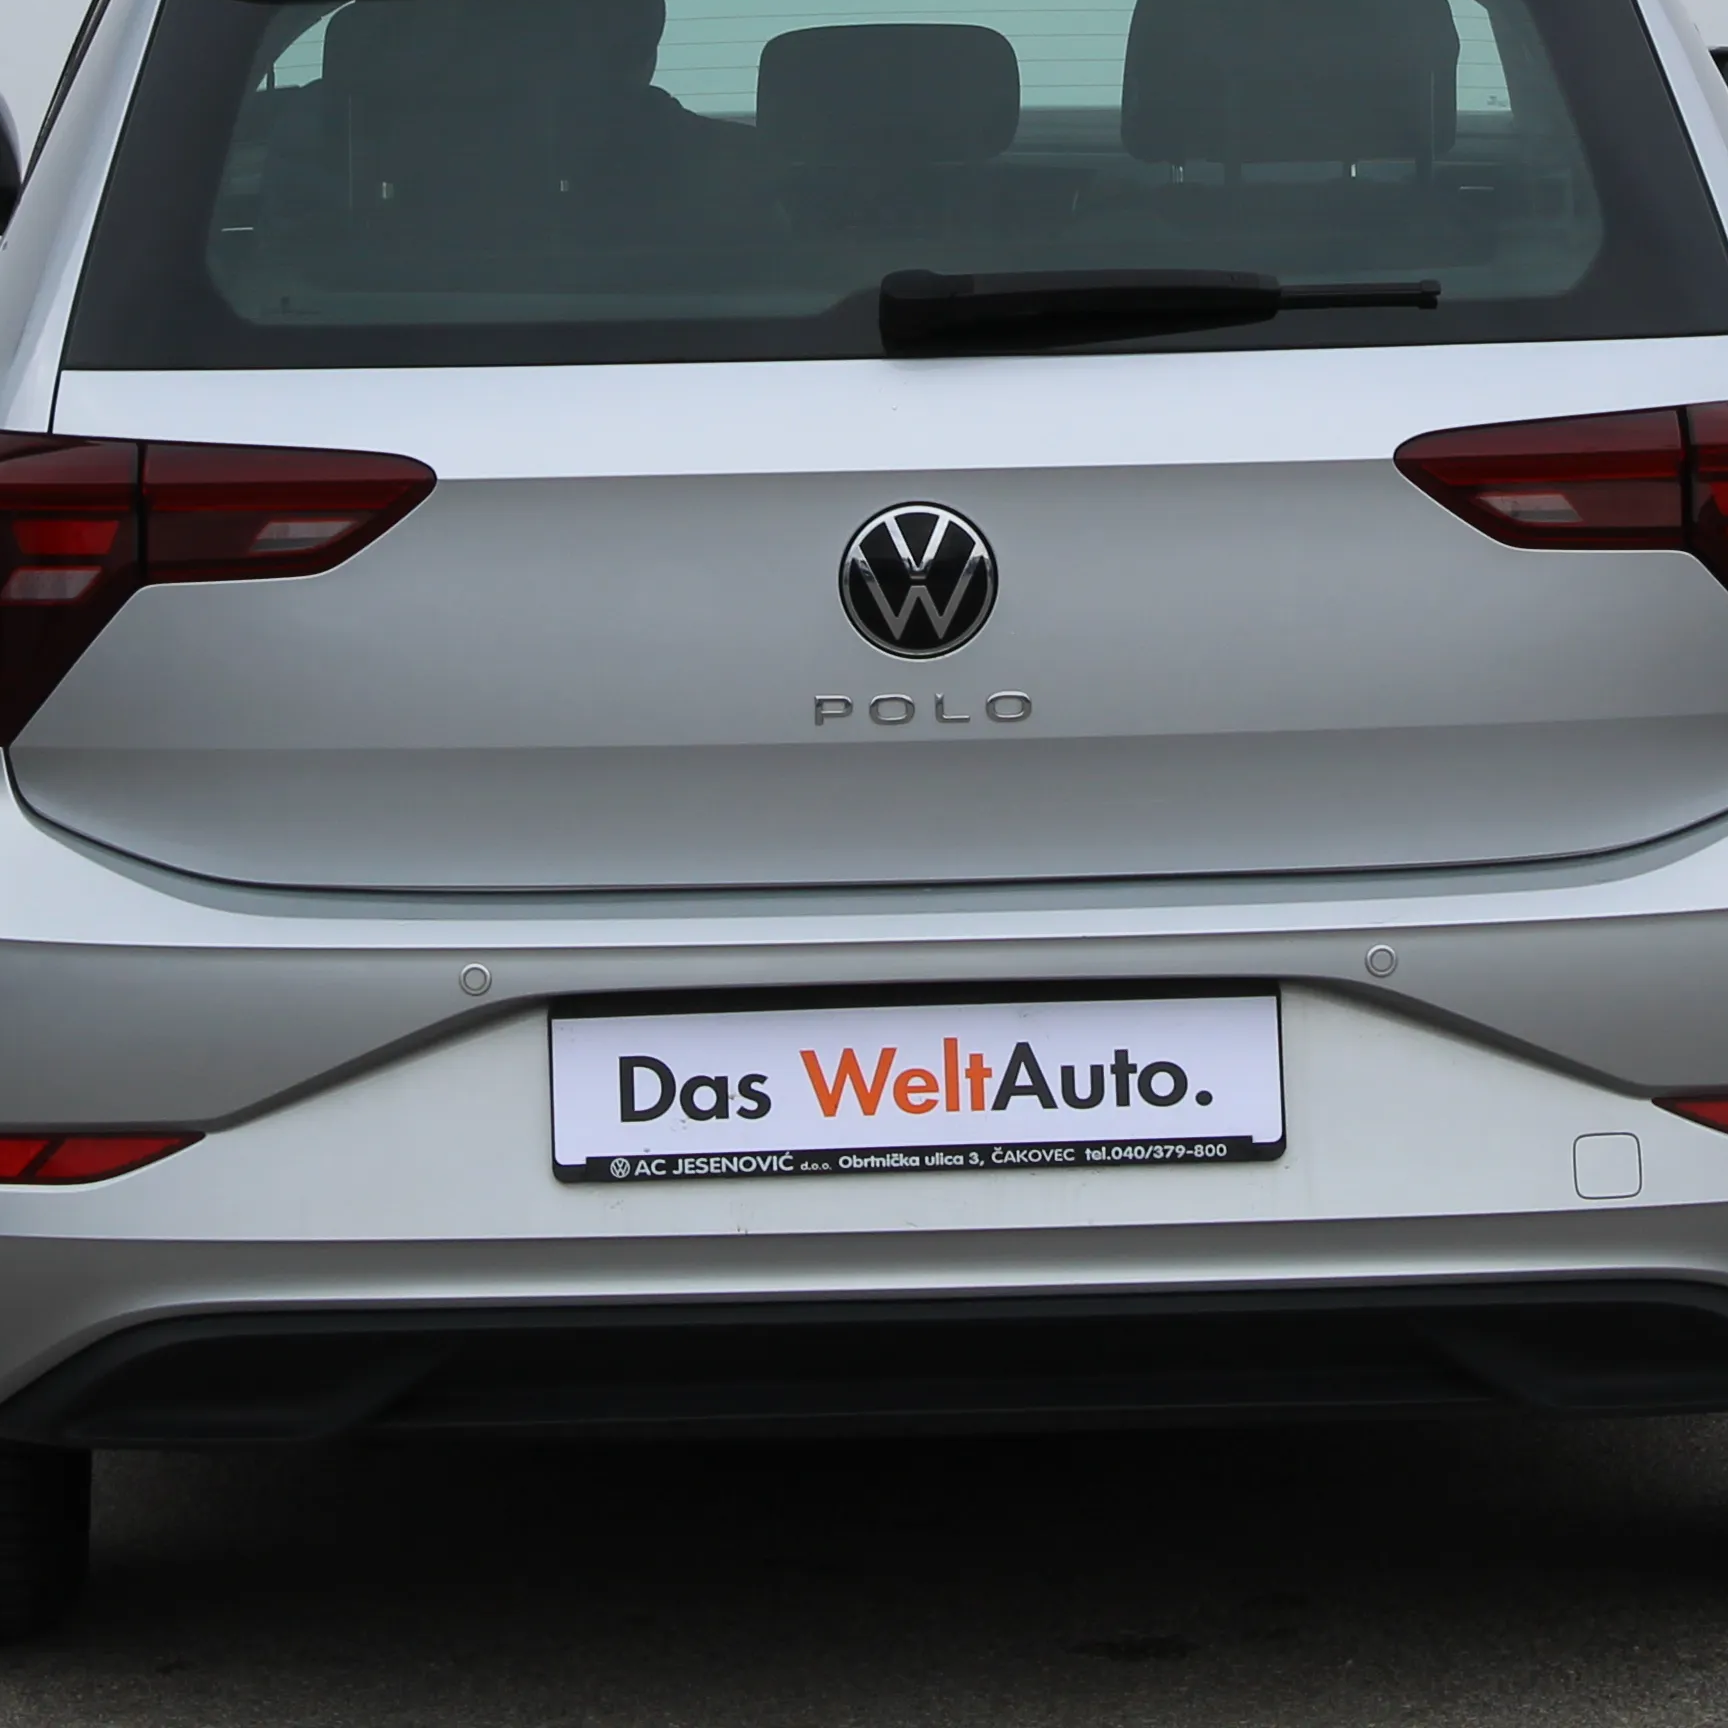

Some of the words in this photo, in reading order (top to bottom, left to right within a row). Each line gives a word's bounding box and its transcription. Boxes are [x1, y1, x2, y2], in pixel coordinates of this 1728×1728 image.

[814, 690, 1032, 726] POLO
[618, 1055, 772, 1123] Das
[800, 1037, 1213, 1118] WeltAuto.
[634, 1158, 667, 1176] AC
[672, 1151, 794, 1175] JESENOVIĆ
[800, 1161, 832, 1171] d.o.o.
[924, 1152, 964, 1166] ulica
[968, 1152, 985, 1167] 3,
[991, 1146, 1076, 1164] ČAKOVEC
[1085, 1143, 1228, 1161] tel.040/379-800
